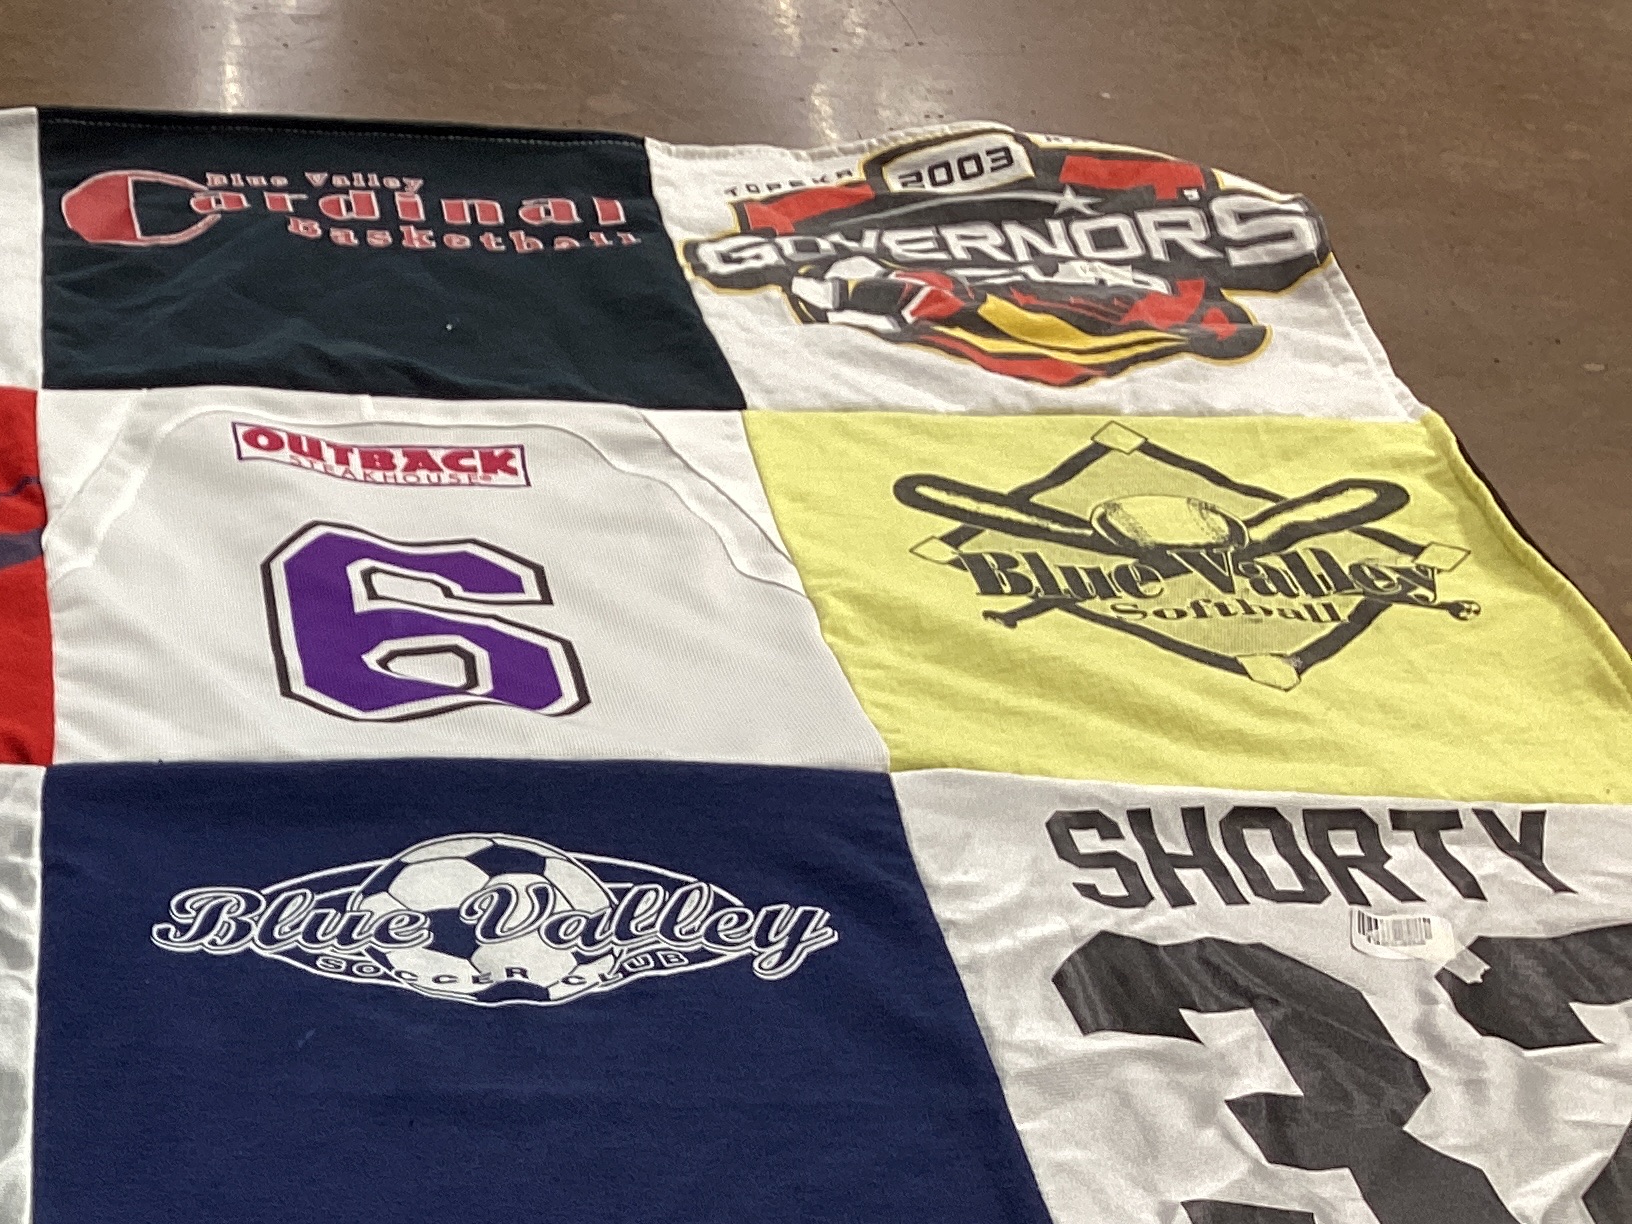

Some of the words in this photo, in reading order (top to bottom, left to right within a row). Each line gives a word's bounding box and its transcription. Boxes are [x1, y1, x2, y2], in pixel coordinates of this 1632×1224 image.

[205, 171, 288, 189] Blue
[304, 171, 424, 194] Valley
[724, 168, 853, 197] TOPEKA
[898, 145, 1014, 189] 2003
[61, 169, 627, 245] Cardinal
[242, 426, 520, 476] OUTBACK
[962, 550, 1165, 600] Blue
[1167, 546, 1438, 603] Valley
[261, 521, 591, 722] 6
[1110, 598, 1349, 623] Softball
[1045, 805, 1577, 909] SHORTY
[151, 886, 434, 953] Blue
[459, 881, 838, 980] Valley
[317, 956, 531, 985] SOCCER
[561, 952, 690, 986] CLUB
